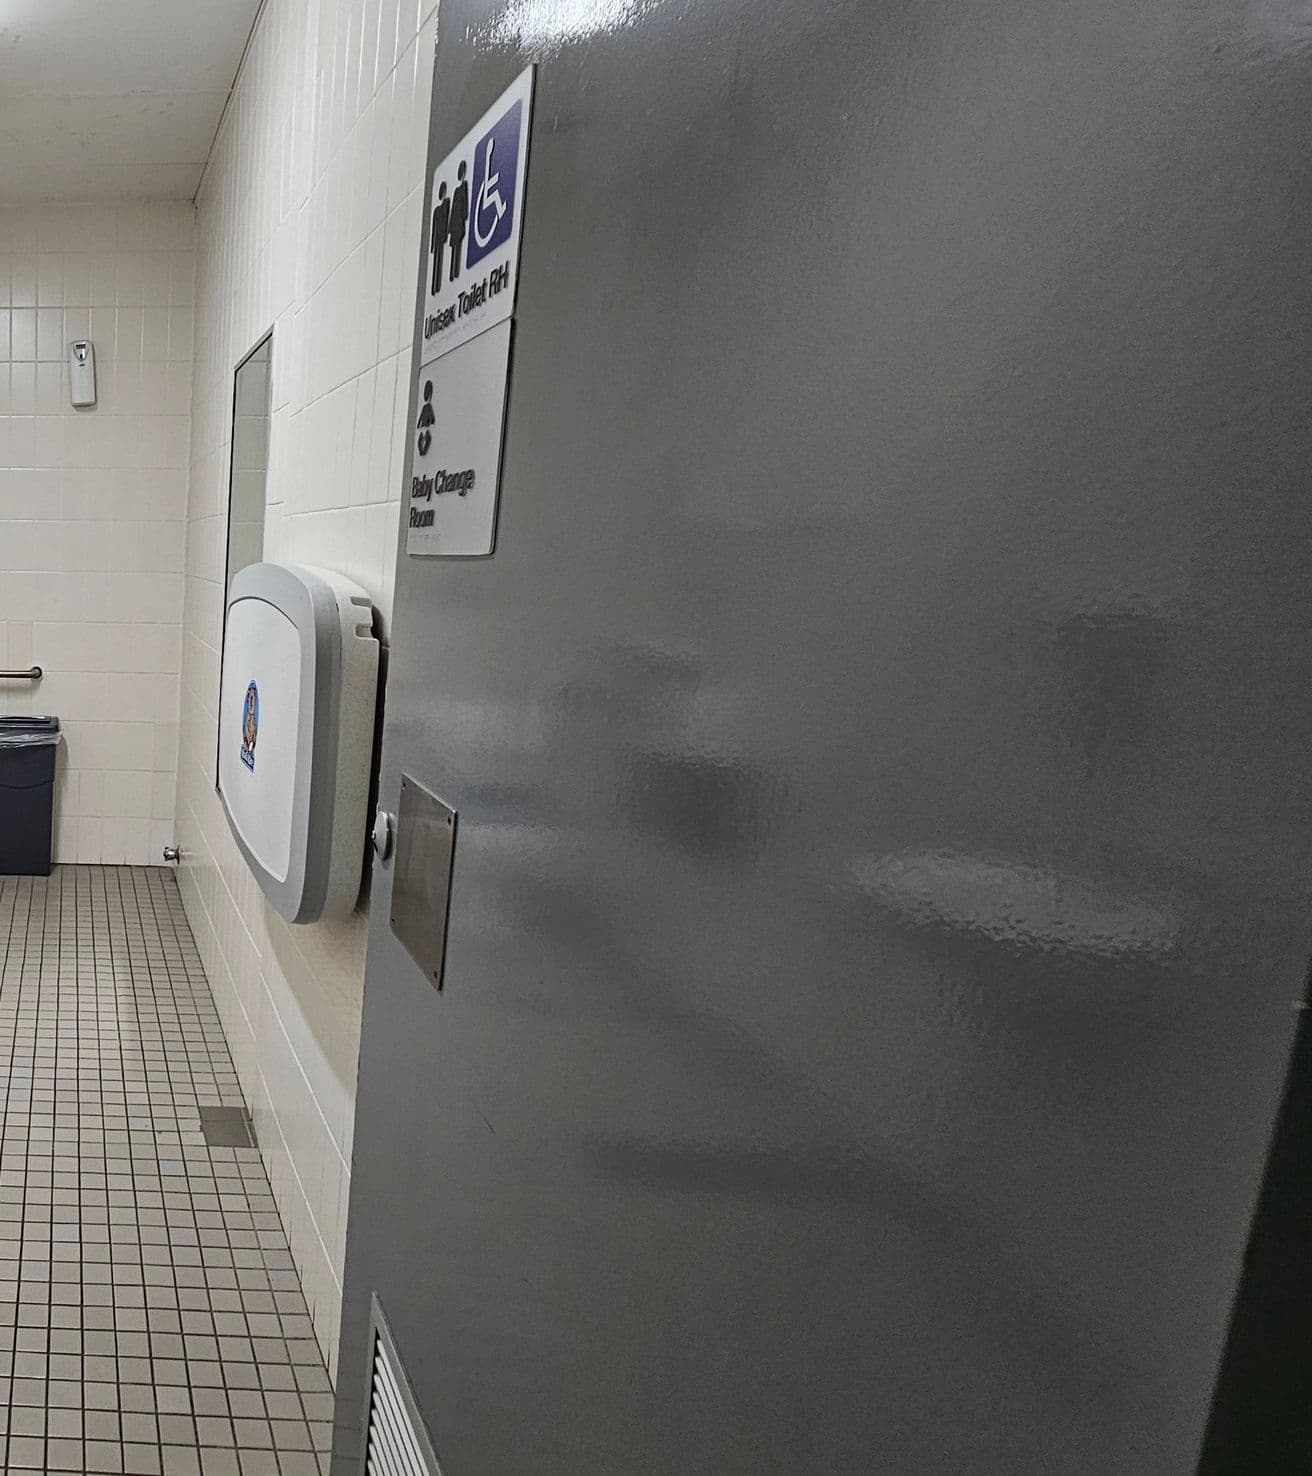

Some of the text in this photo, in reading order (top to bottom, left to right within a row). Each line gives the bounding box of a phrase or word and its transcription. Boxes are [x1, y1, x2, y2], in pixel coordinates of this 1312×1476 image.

[424, 260, 509, 339] Unisex Toilet RH
[412, 469, 475, 502] Baby Change
[409, 507, 435, 528] Room
